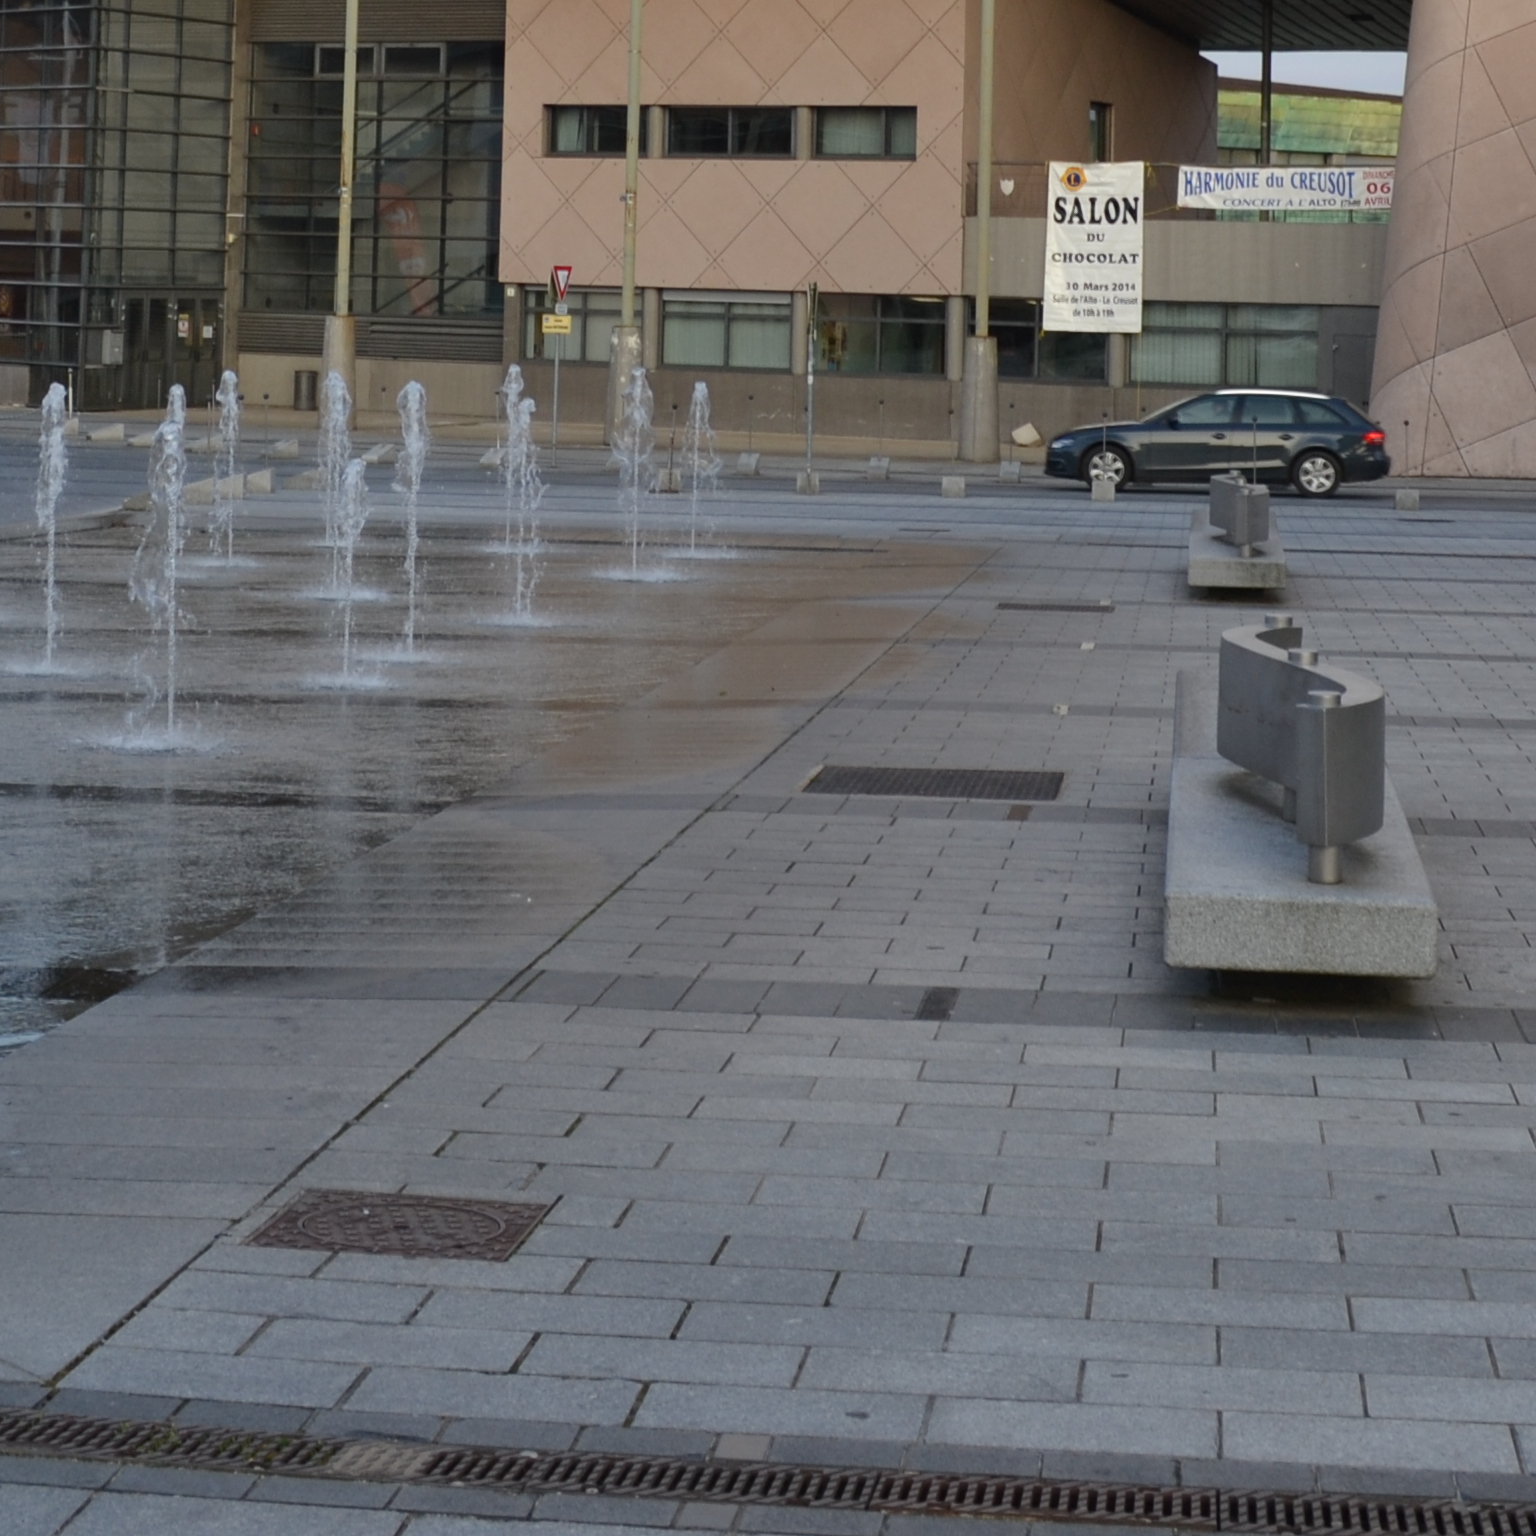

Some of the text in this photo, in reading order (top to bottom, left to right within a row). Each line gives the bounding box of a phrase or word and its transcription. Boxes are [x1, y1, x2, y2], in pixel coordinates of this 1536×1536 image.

[1184, 170, 1356, 199] HARMONIE du CREUSOT
[1366, 182, 1391, 195] 06
[1223, 198, 1282, 207] CONCERT
[1364, 196, 1391, 206] AVRIL
[1053, 196, 1139, 224] SALON
[1086, 233, 1105, 242] DU
[1051, 252, 1139, 264] CHOCOLAT
[1083, 282, 1109, 291] Mars
[1111, 282, 1136, 292] 2014
[1070, 295, 1079, 304] de
[1102, 295, 1111, 304] Le
[1112, 295, 1138, 305] Creusot
